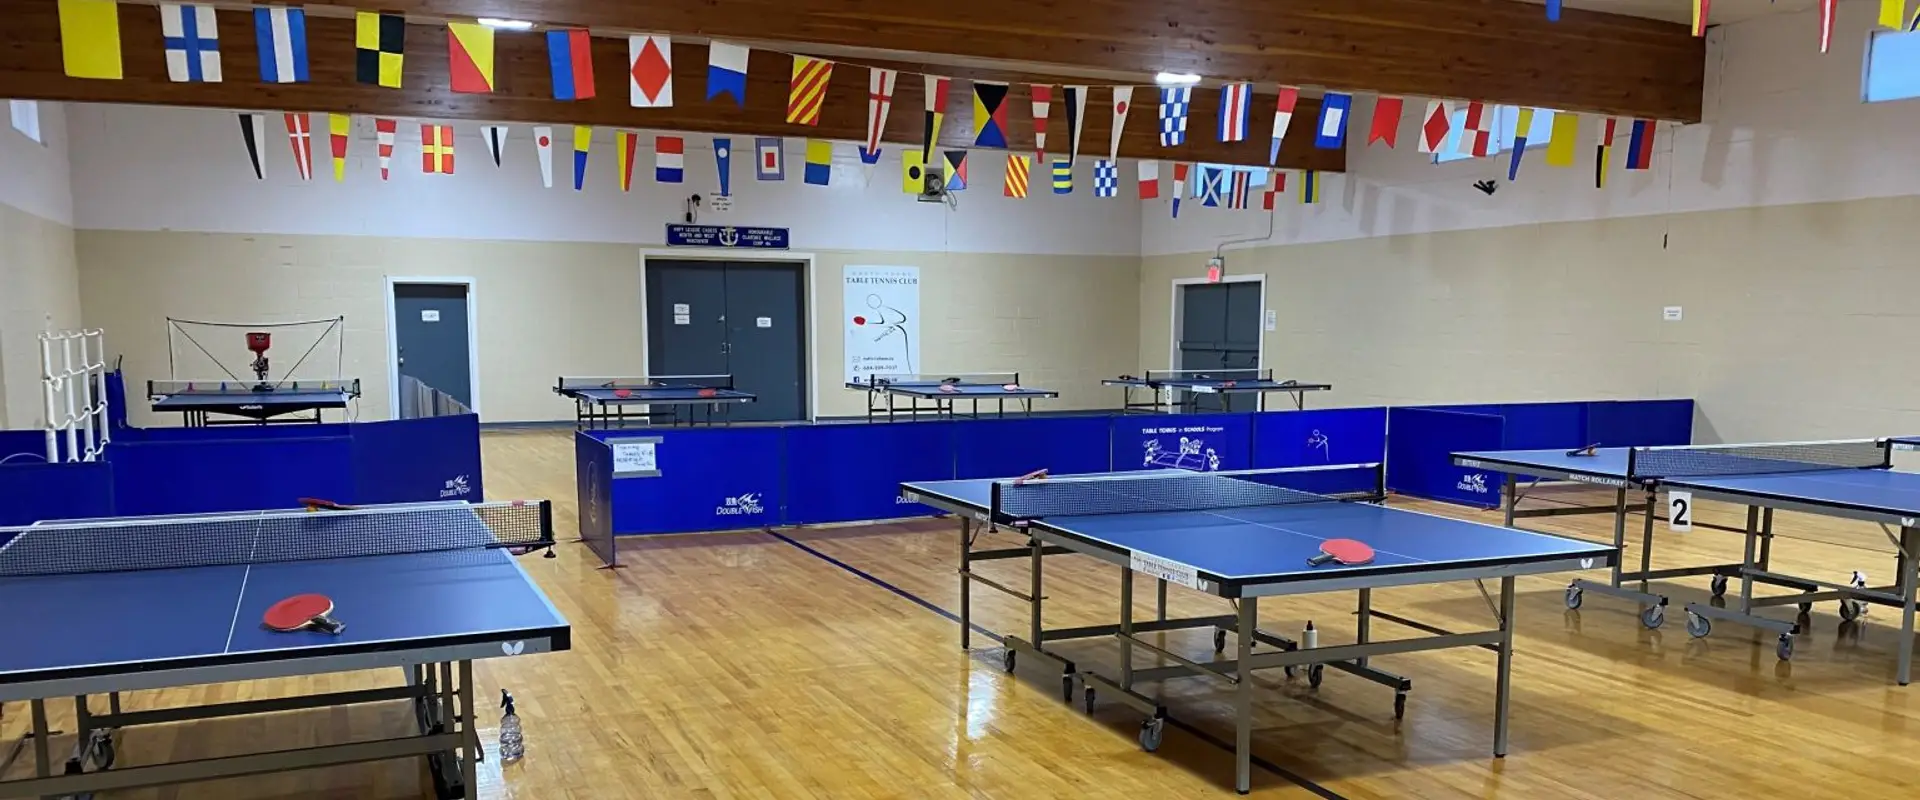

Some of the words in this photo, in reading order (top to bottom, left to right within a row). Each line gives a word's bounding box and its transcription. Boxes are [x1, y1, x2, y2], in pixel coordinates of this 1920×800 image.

[870, 277, 897, 285] TENNIS
[1569, 473, 1590, 482] MATCH
[1591, 476, 1624, 486] ROLLAWAY
[716, 506, 744, 515] DOUBLE
[1673, 498, 1688, 525] 2
